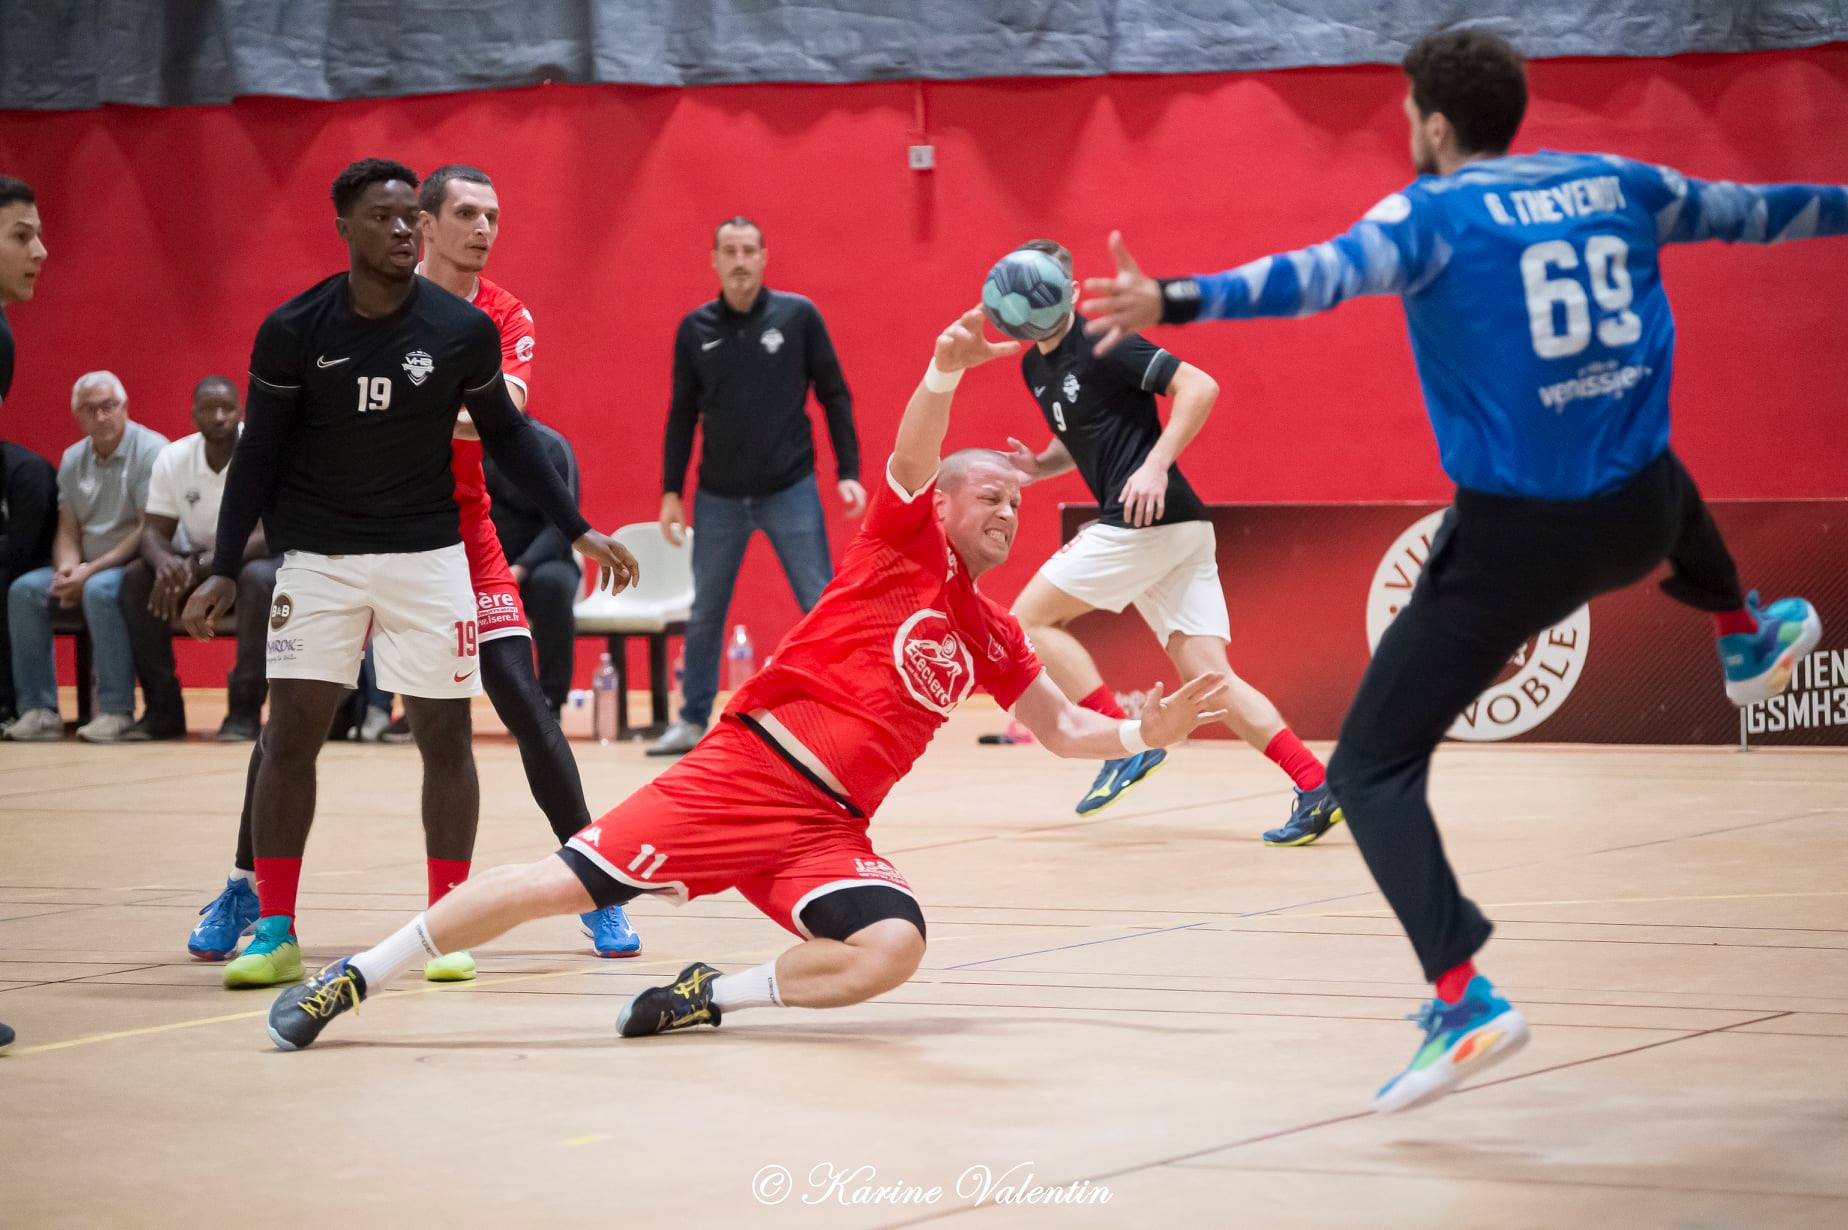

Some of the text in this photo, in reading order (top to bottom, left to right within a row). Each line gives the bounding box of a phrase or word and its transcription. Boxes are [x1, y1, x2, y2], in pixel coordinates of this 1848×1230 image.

[1520, 234, 1642, 360] 69
[357, 376, 392, 412] 19
[1052, 401, 1067, 432] 9
[475, 592, 516, 610] ère
[454, 620, 477, 657] 19
[626, 843, 669, 880] 11
